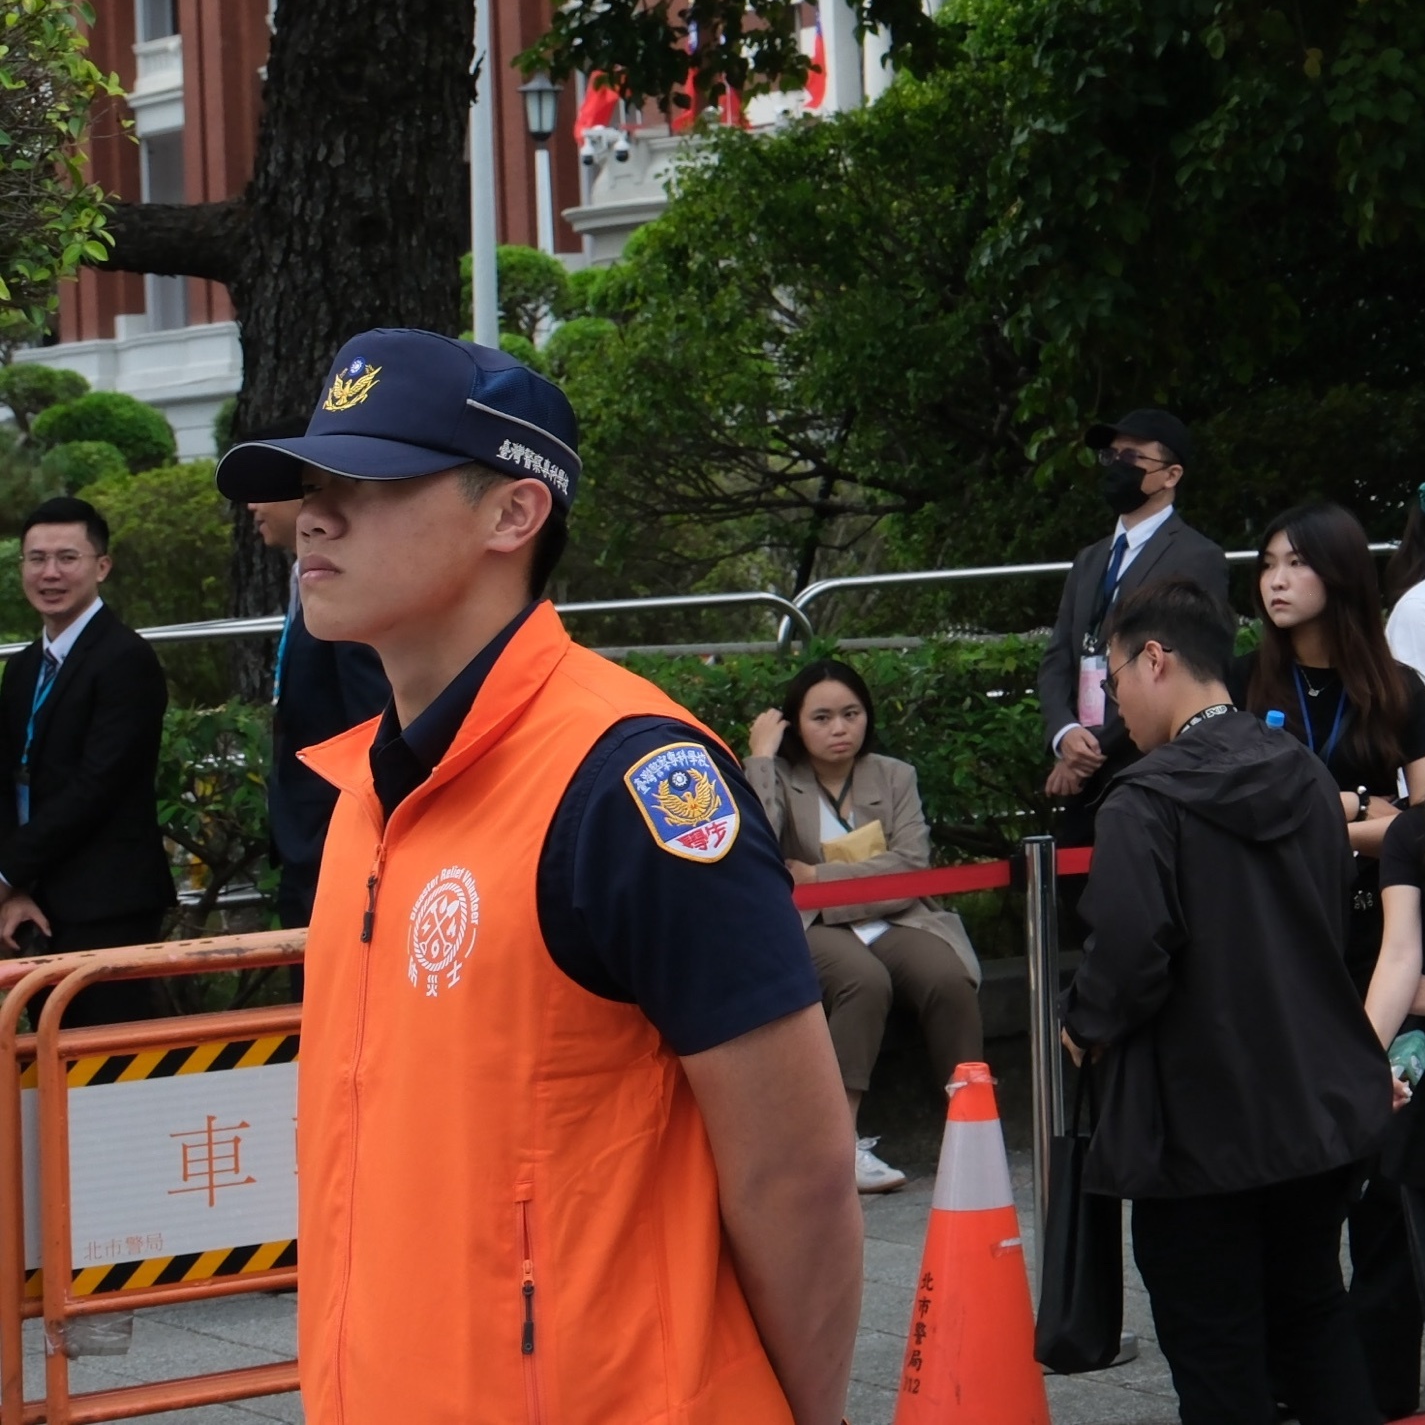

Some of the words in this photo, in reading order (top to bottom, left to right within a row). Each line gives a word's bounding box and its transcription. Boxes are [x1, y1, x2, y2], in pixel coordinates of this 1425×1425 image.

[462, 870, 480, 925] Volunteer
[168, 1115, 297, 1208] 車
[84, 1232, 163, 1261] 北市警局
[908, 1272, 934, 1371] 北市警局
